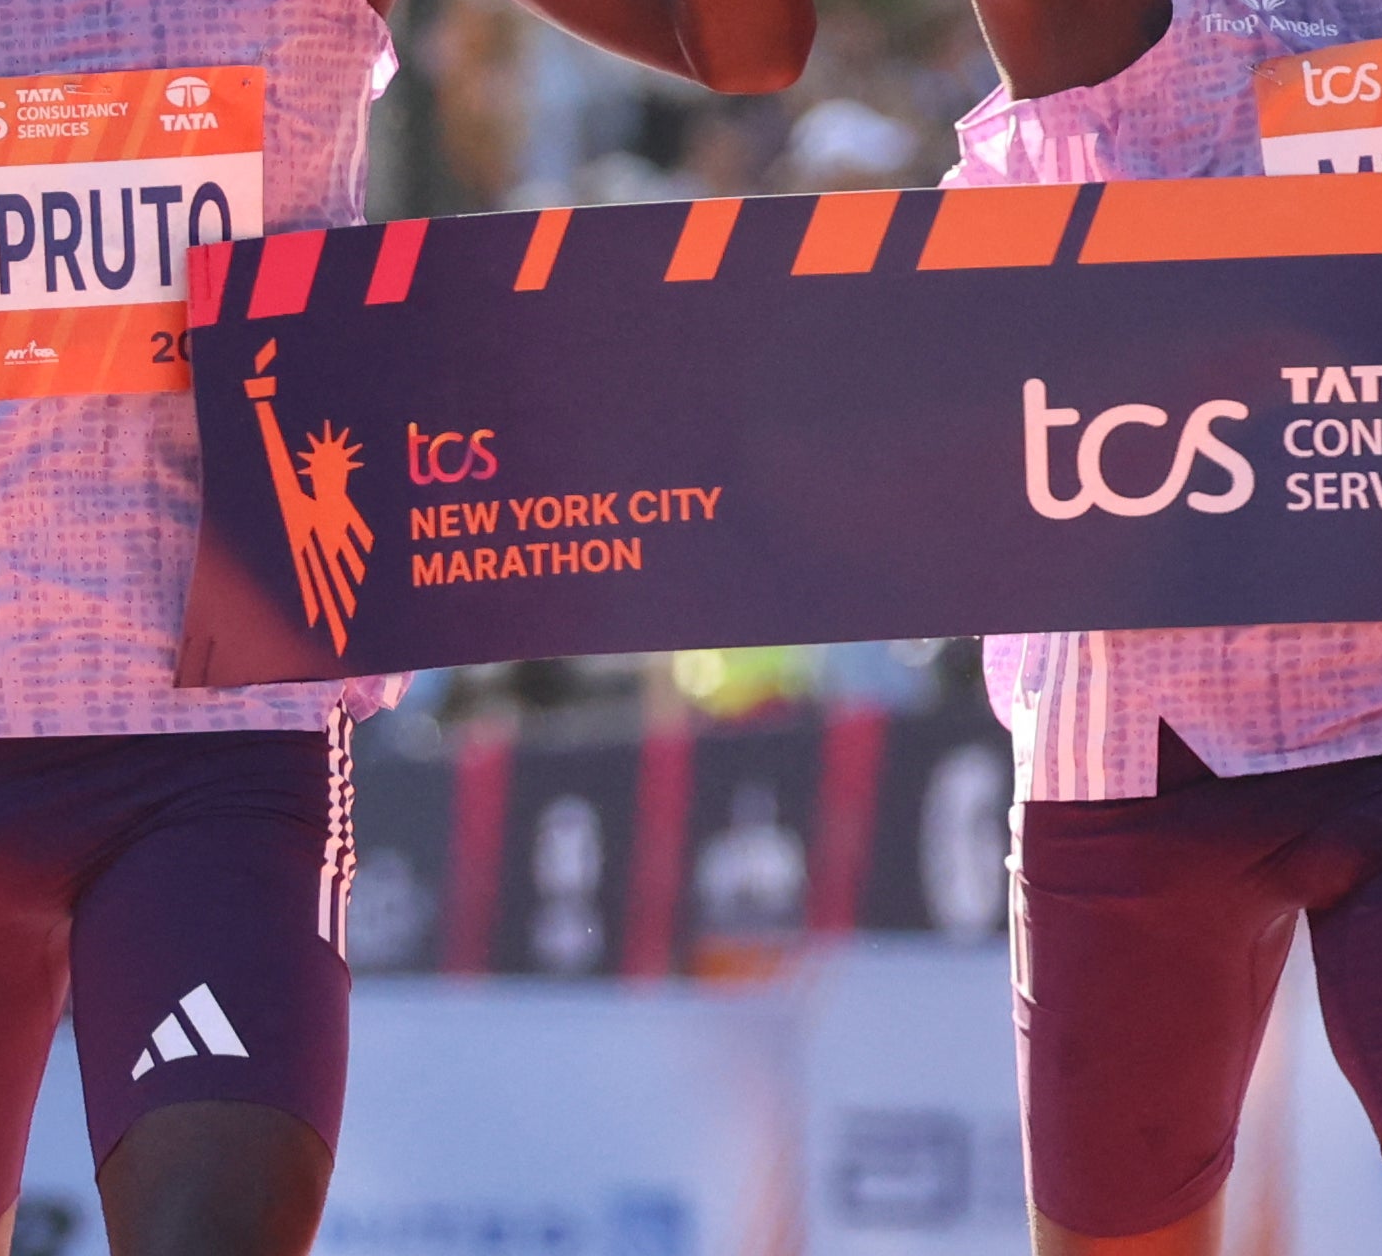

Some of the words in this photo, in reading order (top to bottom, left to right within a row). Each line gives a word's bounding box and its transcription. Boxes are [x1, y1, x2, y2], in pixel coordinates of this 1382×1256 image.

[1269, 15, 1339, 37] Angels
[15, 88, 65, 103] TATA
[1302, 60, 1381, 106] tcs
[16, 102, 129, 122] CONSULTANCY
[159, 112, 219, 131] TATA
[17, 121, 90, 139] SERVICES
[407, 421, 498, 486] tcs
[1022, 378, 1255, 519] tcs
[410, 500, 500, 540] NEW
[508, 492, 619, 531] YORK
[628, 486, 723, 524] CITY
[411, 537, 642, 588] MARATHON
